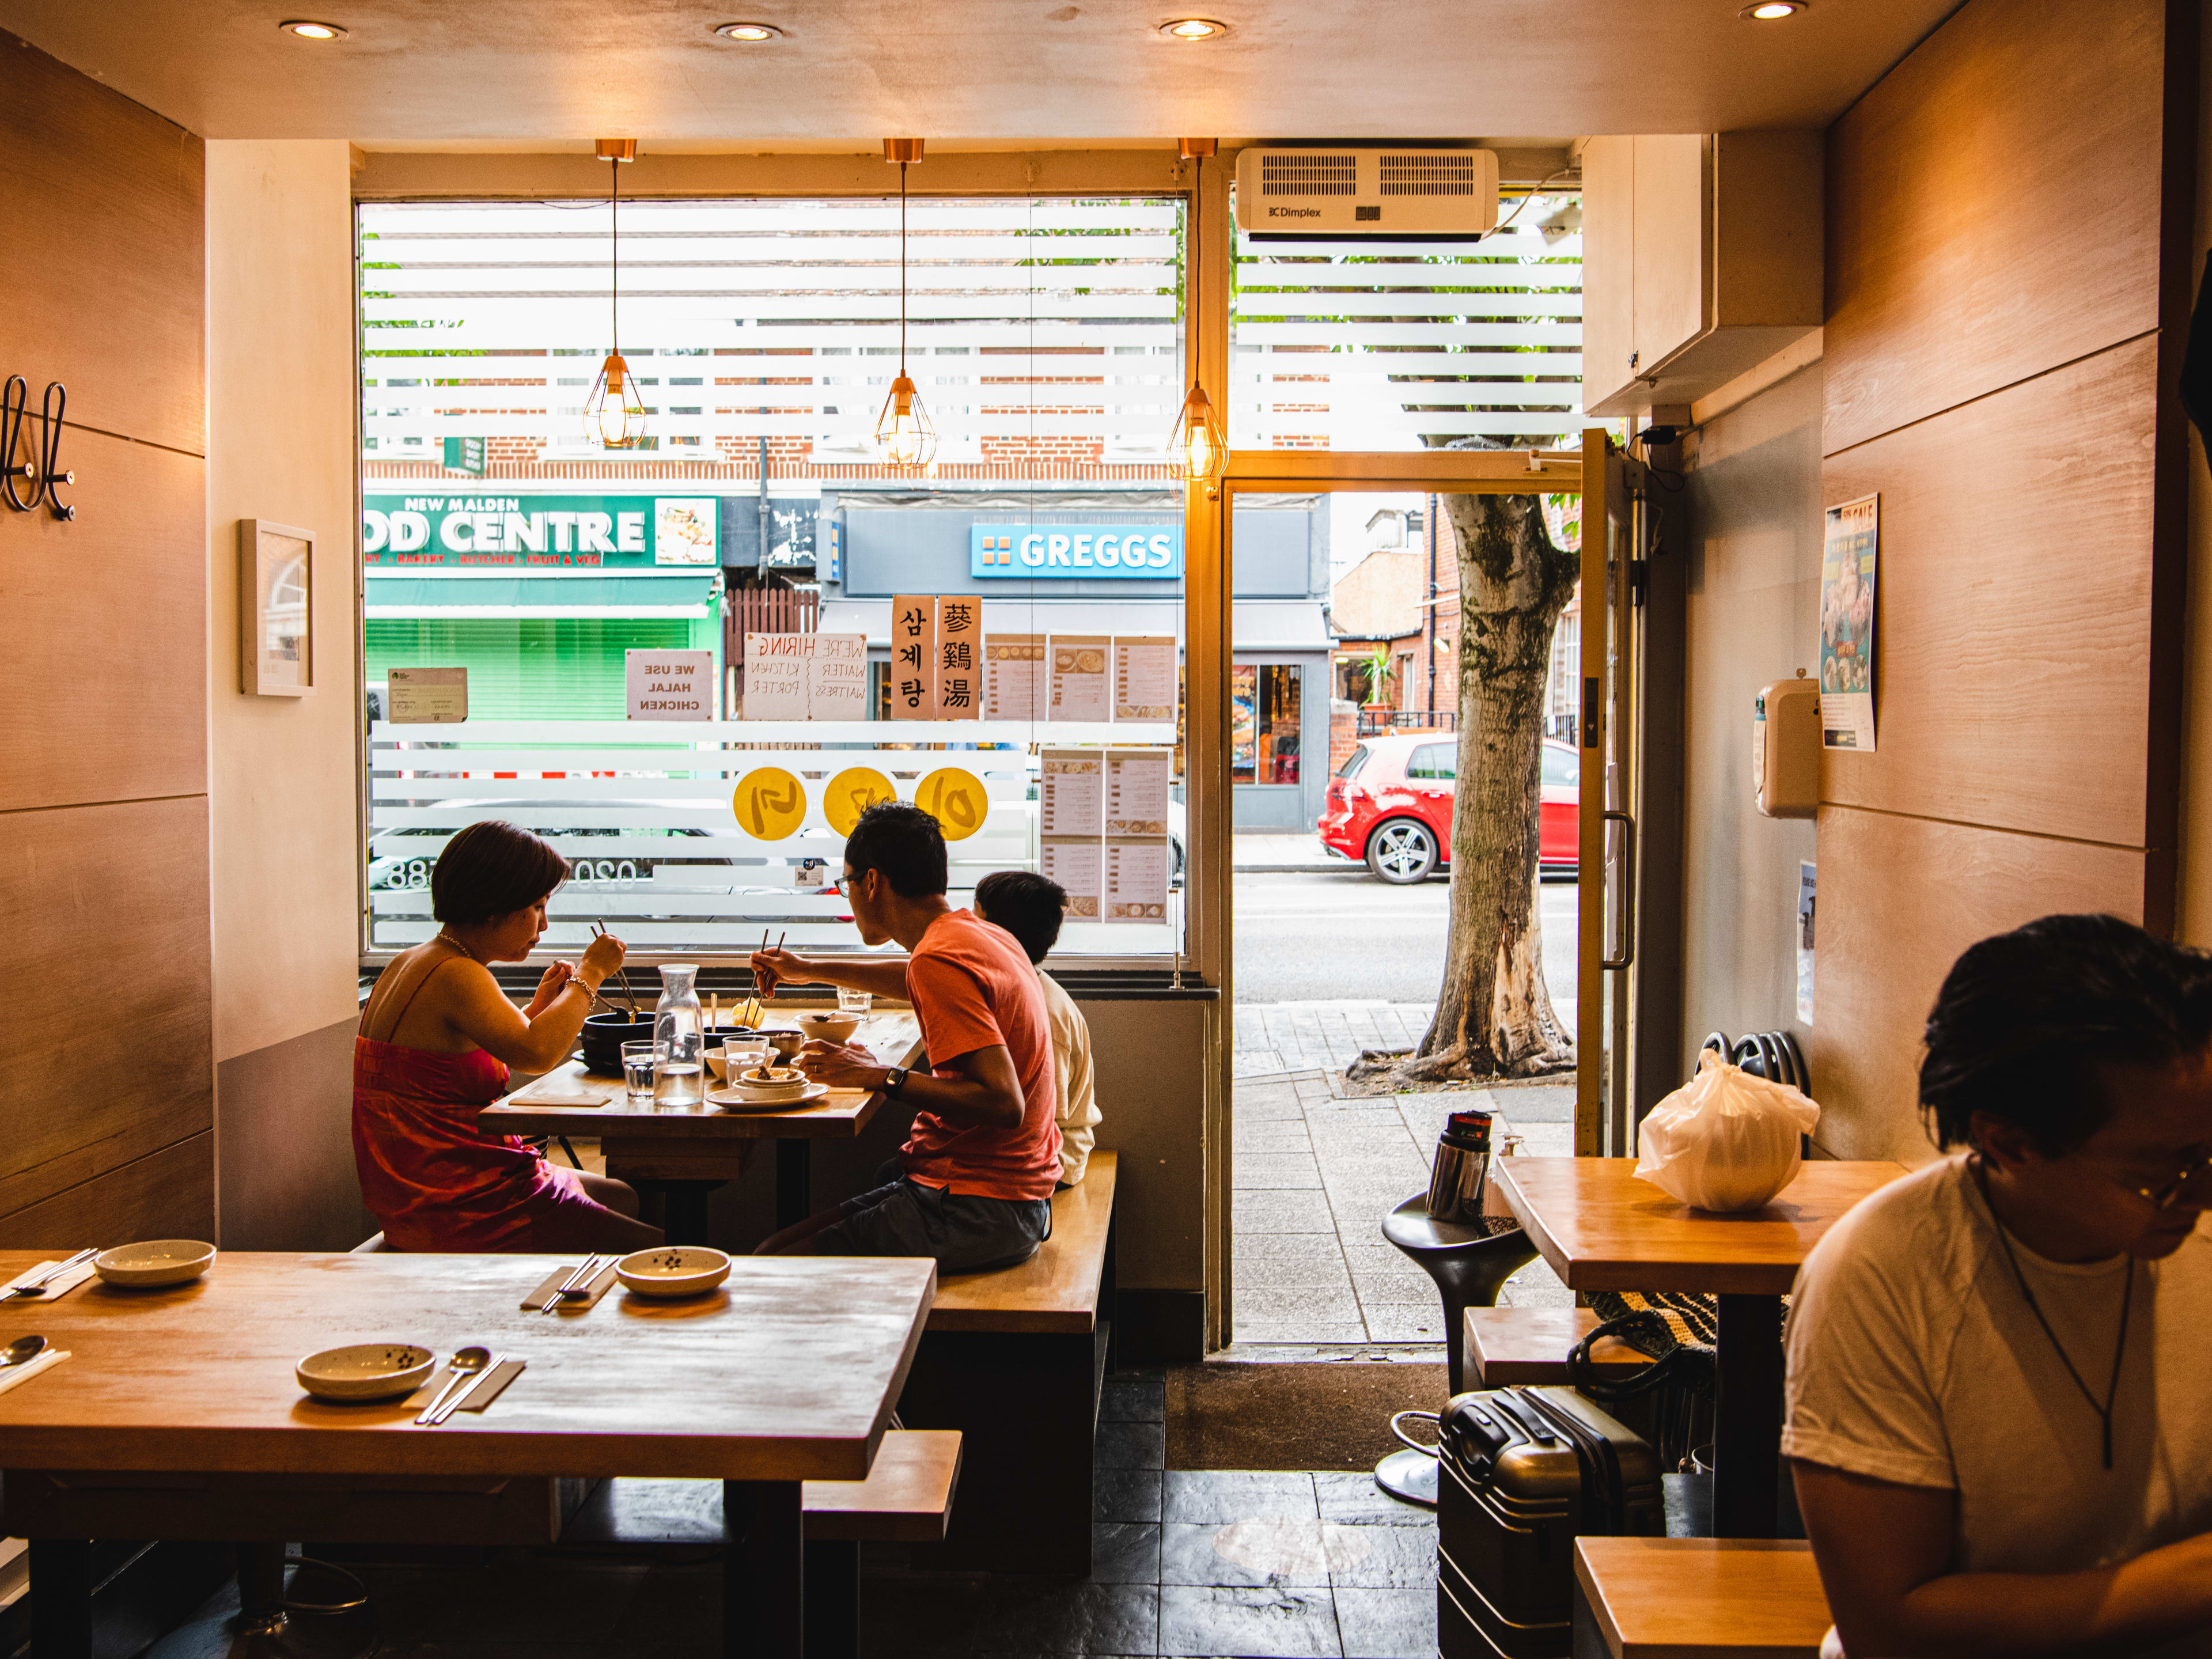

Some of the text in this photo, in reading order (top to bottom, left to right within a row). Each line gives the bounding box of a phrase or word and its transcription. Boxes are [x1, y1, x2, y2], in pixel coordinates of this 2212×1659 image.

[1281, 207, 1321, 218] Dimplex
[404, 498, 519, 512] NEW MALDEN
[440, 510, 646, 553] CENTRE
[397, 554, 445, 565] BAKERY
[459, 554, 515, 565] BUTCHER
[527, 554, 560, 565] FRUIT
[563, 554, 572, 565] &
[575, 554, 600, 565] VEG
[1020, 534, 1172, 568] GREGGS
[899, 607, 927, 708] 삼계탕
